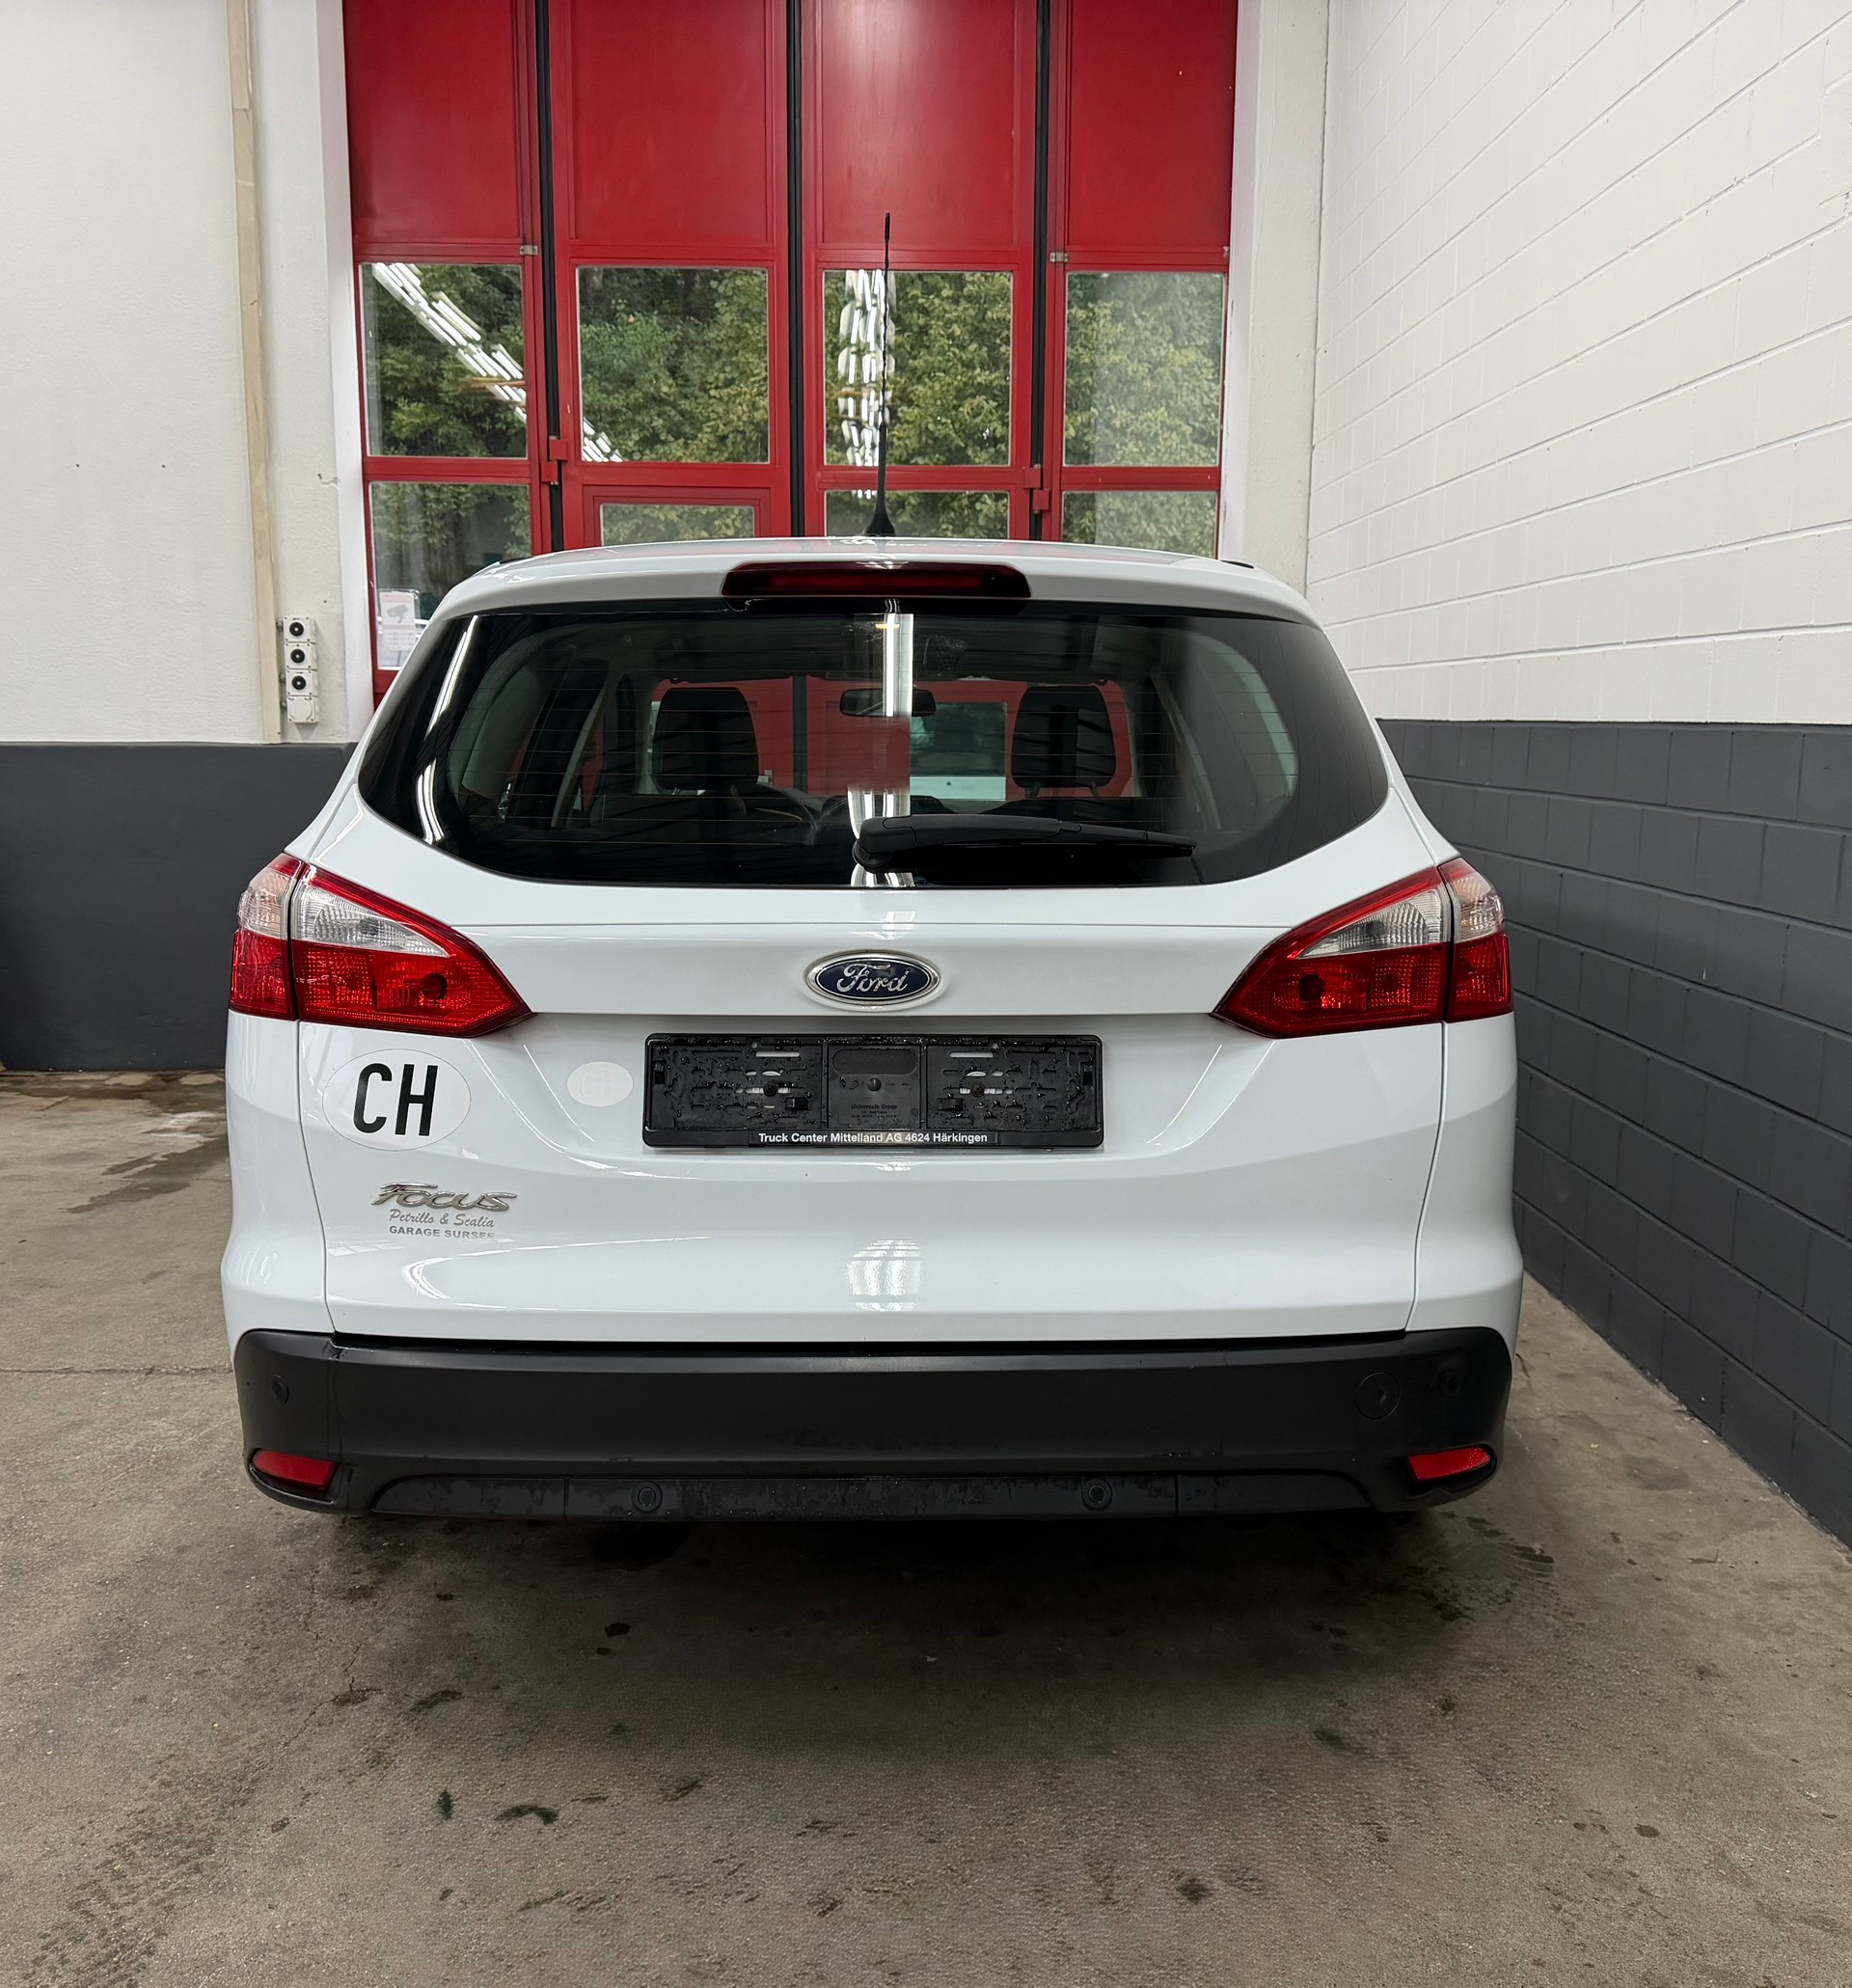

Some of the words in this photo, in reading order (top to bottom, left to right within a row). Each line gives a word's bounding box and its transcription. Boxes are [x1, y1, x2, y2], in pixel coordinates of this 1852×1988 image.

[836, 964, 908, 993] Ford
[353, 1063, 438, 1136] CH
[758, 1132, 789, 1143] Truck
[791, 1132, 829, 1143] Center
[831, 1132, 884, 1143] Mittelland
[886, 1132, 902, 1143] AG
[905, 1132, 930, 1143] 4624
[933, 1132, 988, 1145] Härkingen
[389, 1208, 435, 1225] Petrillo
[439, 1212, 449, 1225] &
[452, 1213, 495, 1228] Scalia
[389, 1225, 441, 1238] GARAGE
[444, 1229, 496, 1239] SURSEE
